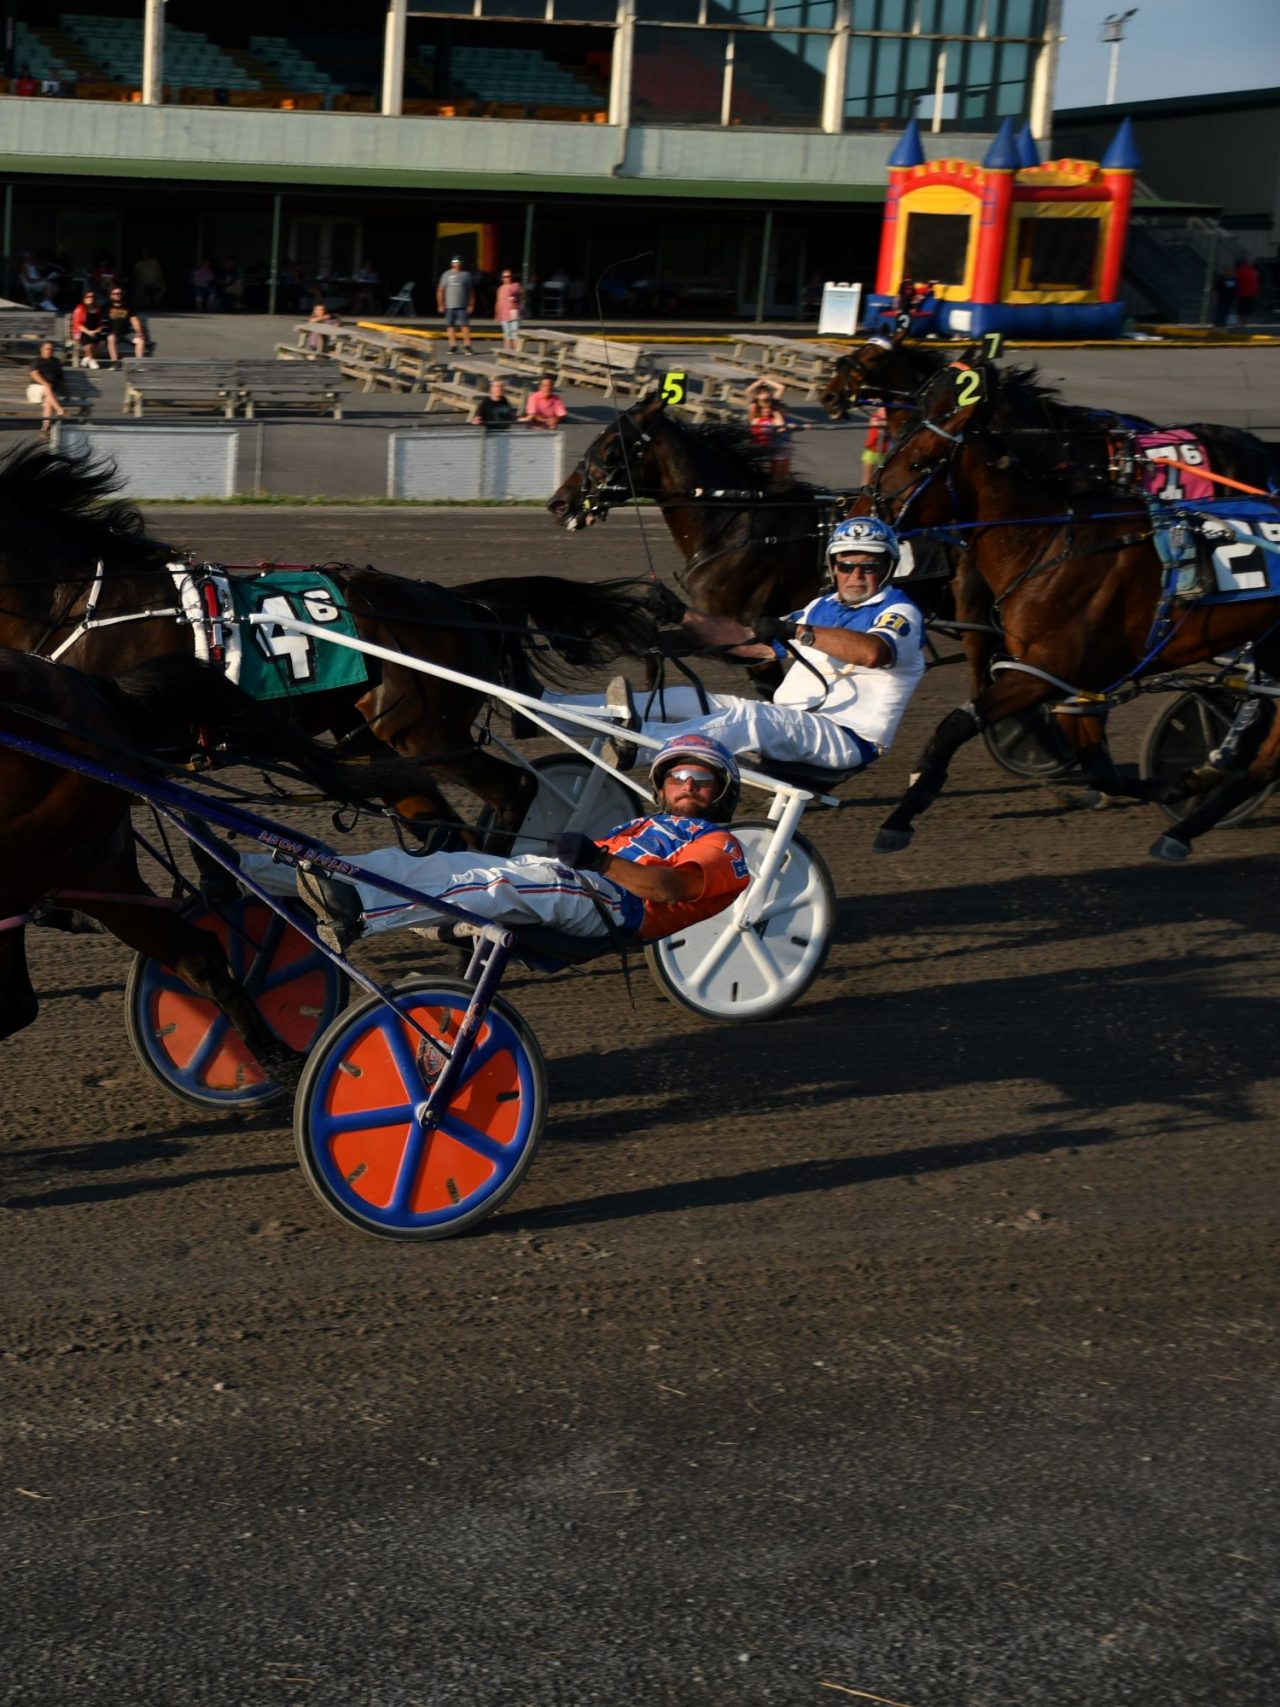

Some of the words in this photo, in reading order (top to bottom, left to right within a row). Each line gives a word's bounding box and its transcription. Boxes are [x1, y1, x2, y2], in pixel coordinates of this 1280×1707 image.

[983, 332, 1002, 359] 7
[660, 372, 686, 405] 5
[955, 369, 982, 407] 2
[1201, 519, 1268, 592] 2
[254, 595, 310, 681] 4
[302, 588, 340, 624] 6
